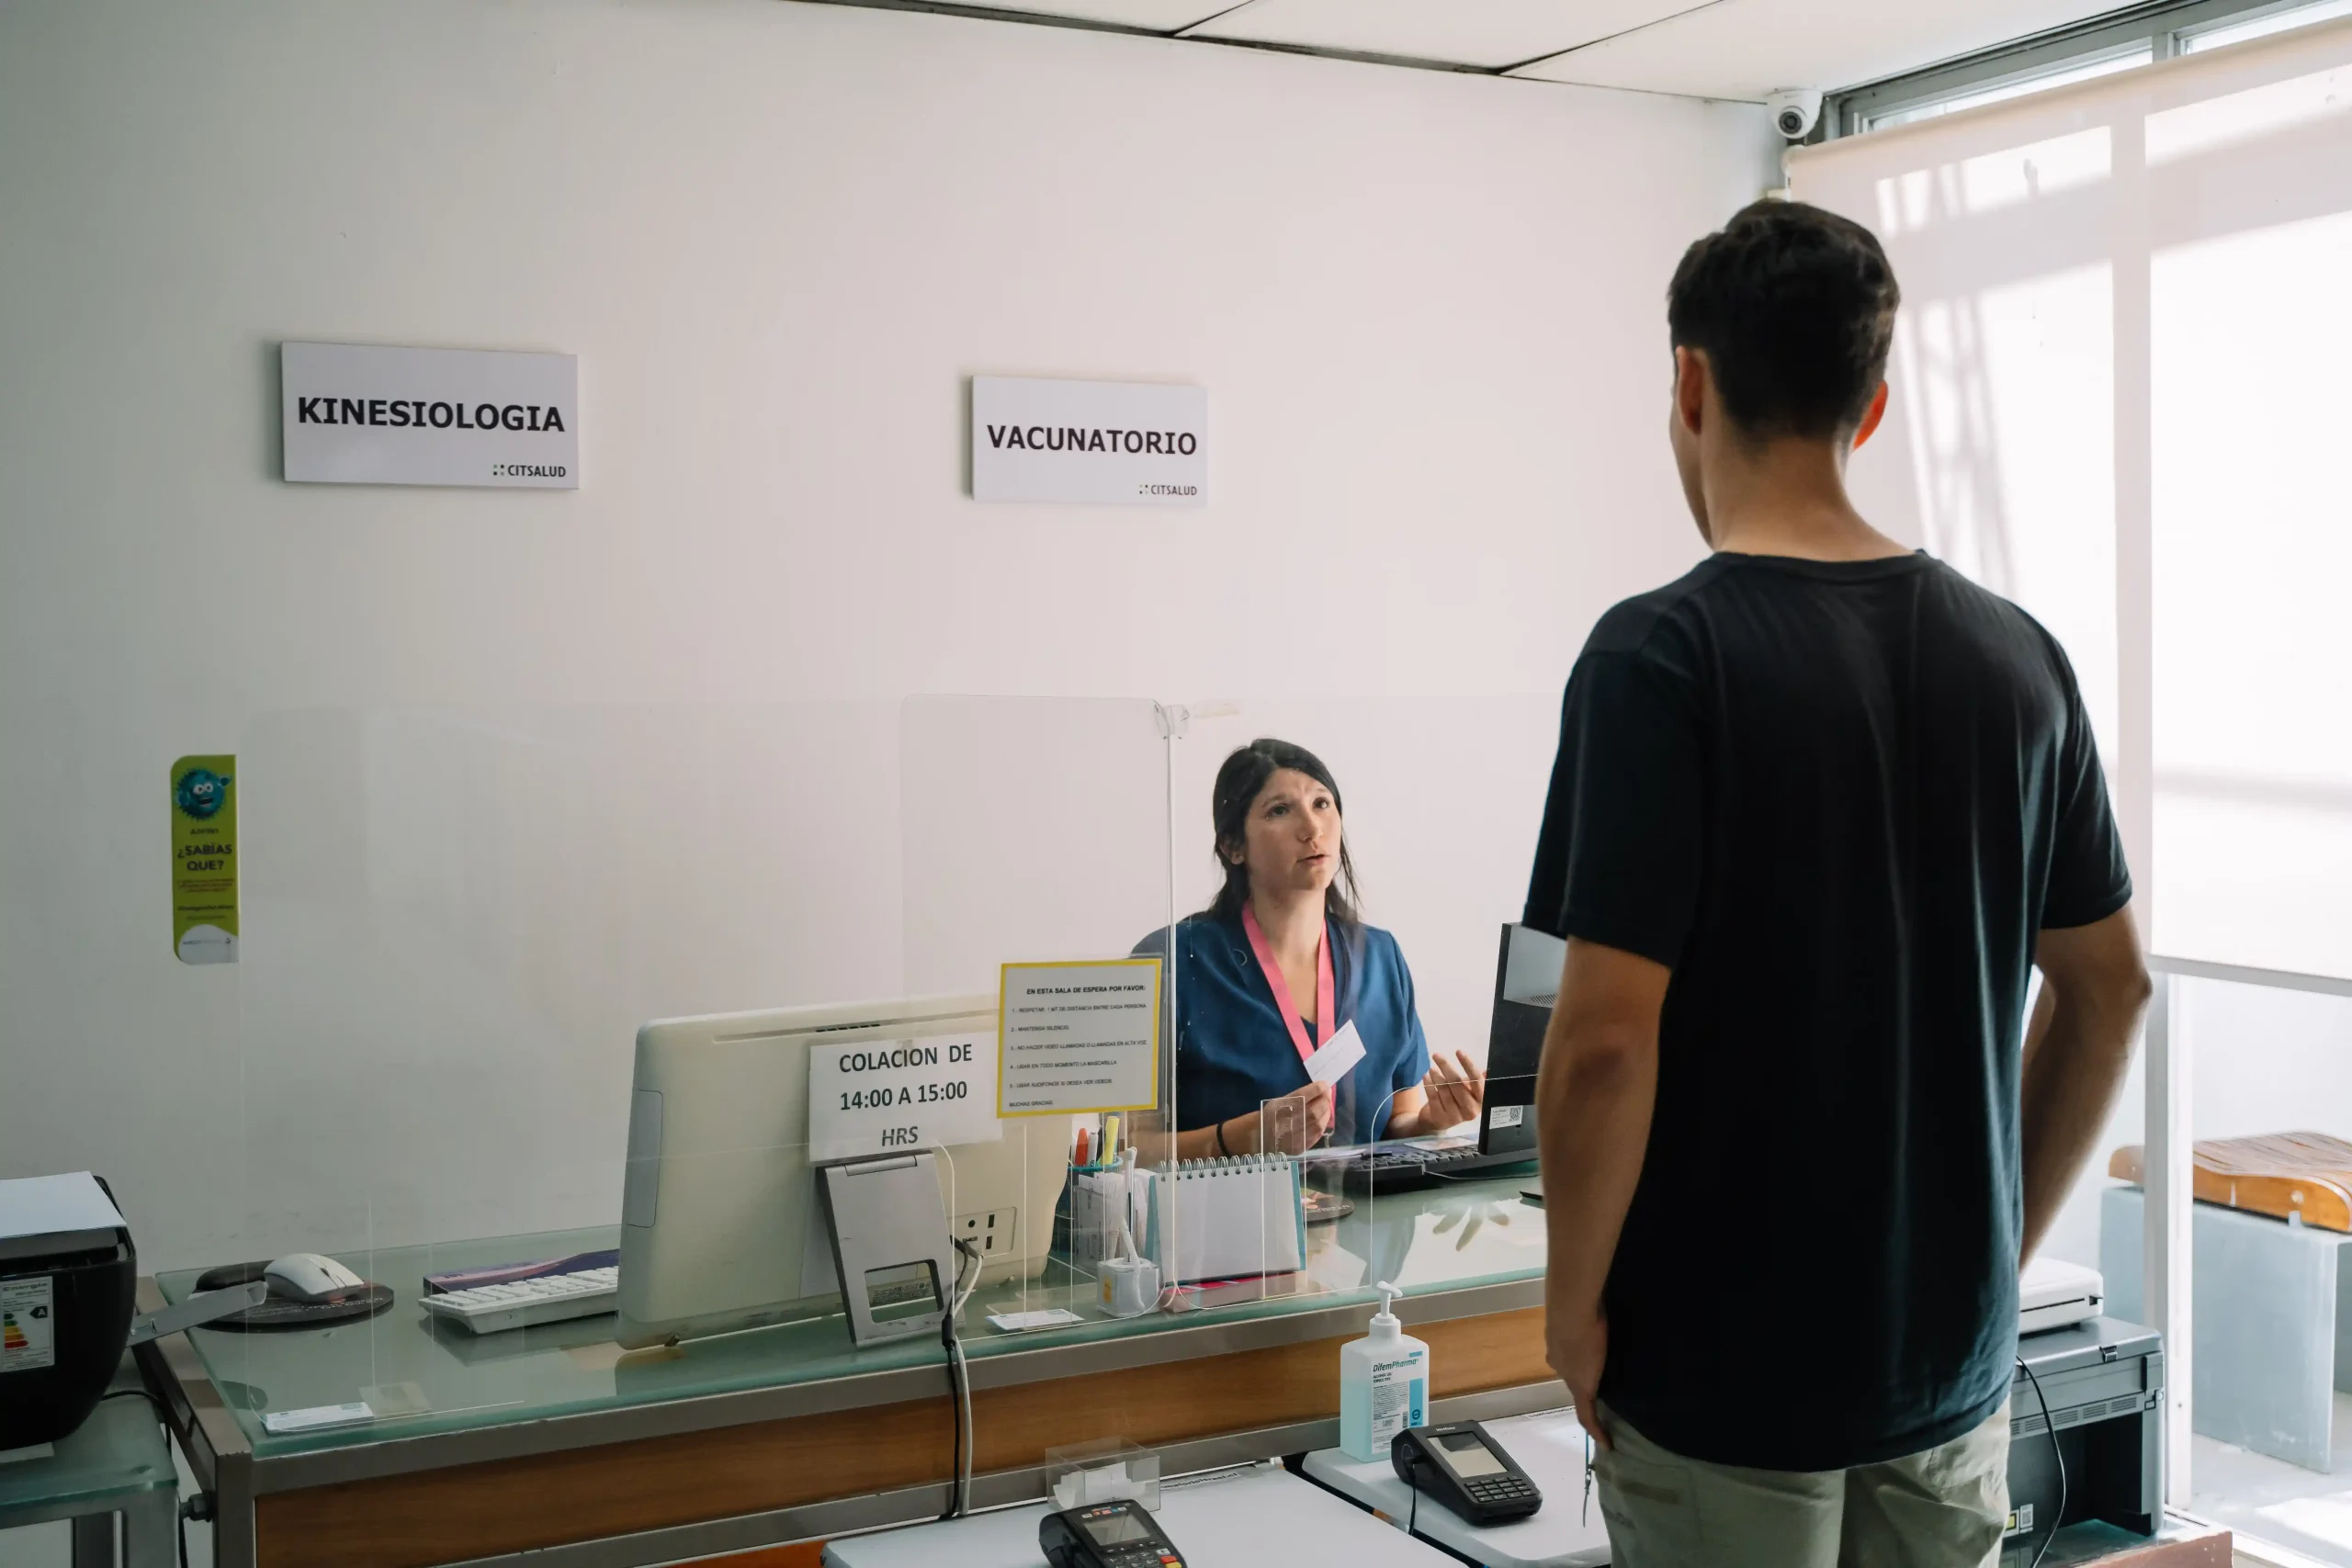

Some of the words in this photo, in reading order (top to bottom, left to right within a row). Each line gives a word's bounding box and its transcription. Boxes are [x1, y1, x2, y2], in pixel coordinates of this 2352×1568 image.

[298, 396, 566, 433] KINESIOLOGIA
[987, 424, 1197, 456] VACUNATORIO
[507, 464, 567, 478] CITSALUD
[1150, 484, 1198, 496] CITSALUD
[839, 1046, 938, 1073] COLACION
[949, 1043, 973, 1063] DE
[840, 1089, 893, 1111] 14:00
[898, 1087, 912, 1105] A
[918, 1080, 968, 1103] 15:00
[881, 1125, 919, 1147] HRS
[1373, 1359, 1417, 1372] DifemPharma
